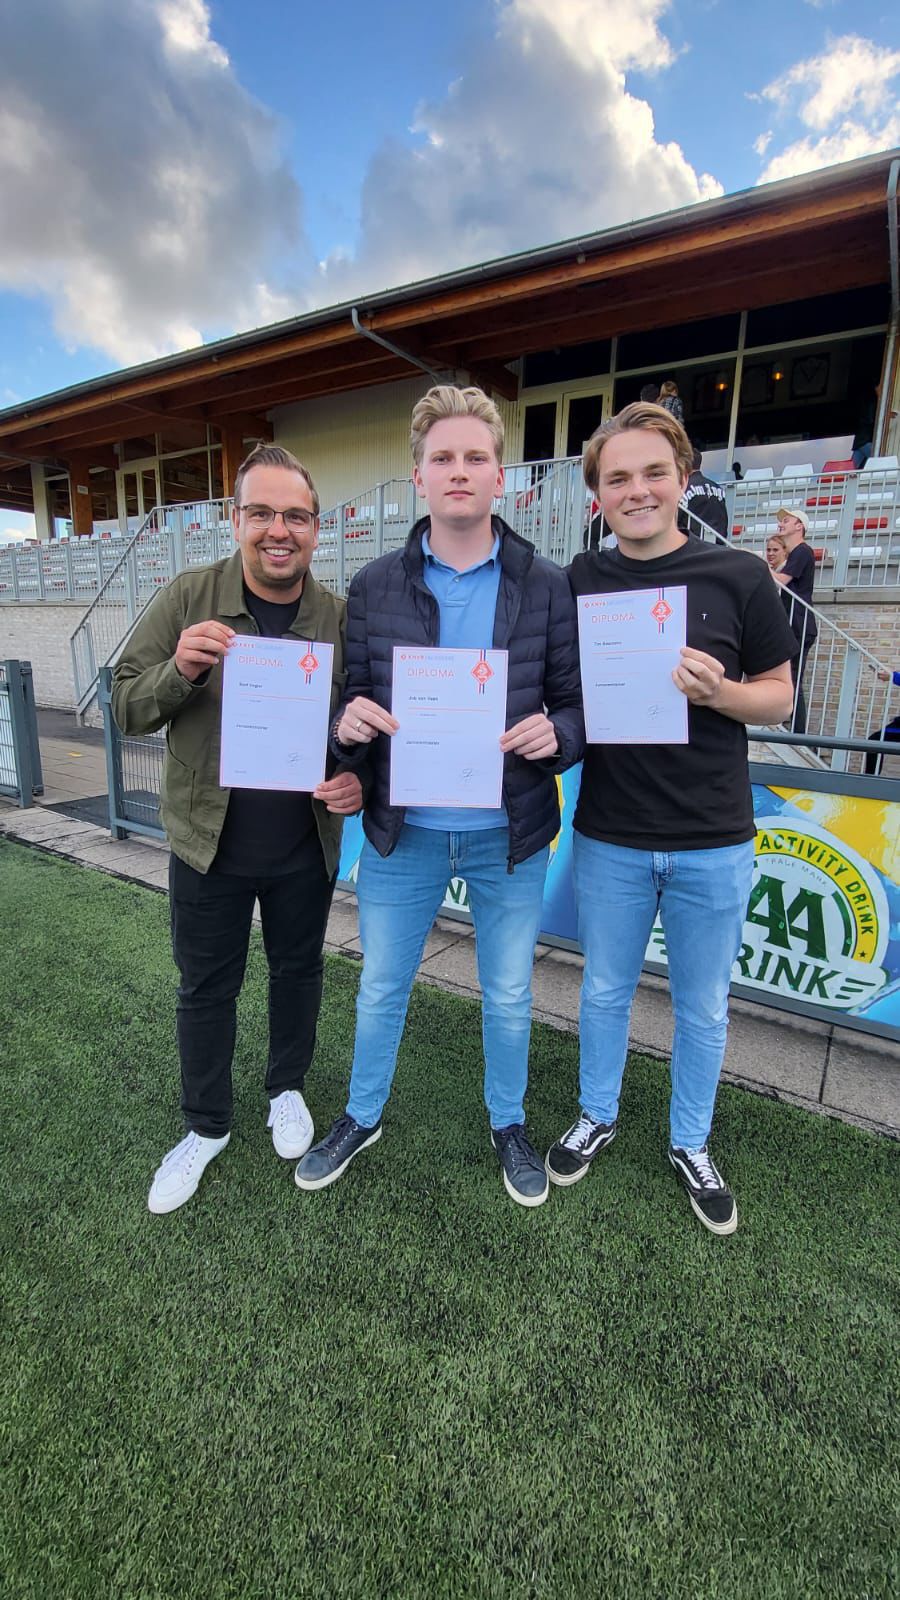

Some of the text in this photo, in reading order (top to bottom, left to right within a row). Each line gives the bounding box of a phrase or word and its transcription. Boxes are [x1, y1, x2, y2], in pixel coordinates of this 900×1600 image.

[591, 613, 635, 623] DIPLOMA
[701, 613, 708, 621] T
[239, 655, 283, 668] DIPLOMA
[407, 667, 454, 677] DIPLOMA
[746, 873, 829, 963] AA
[735, 943, 842, 1000] RINK
